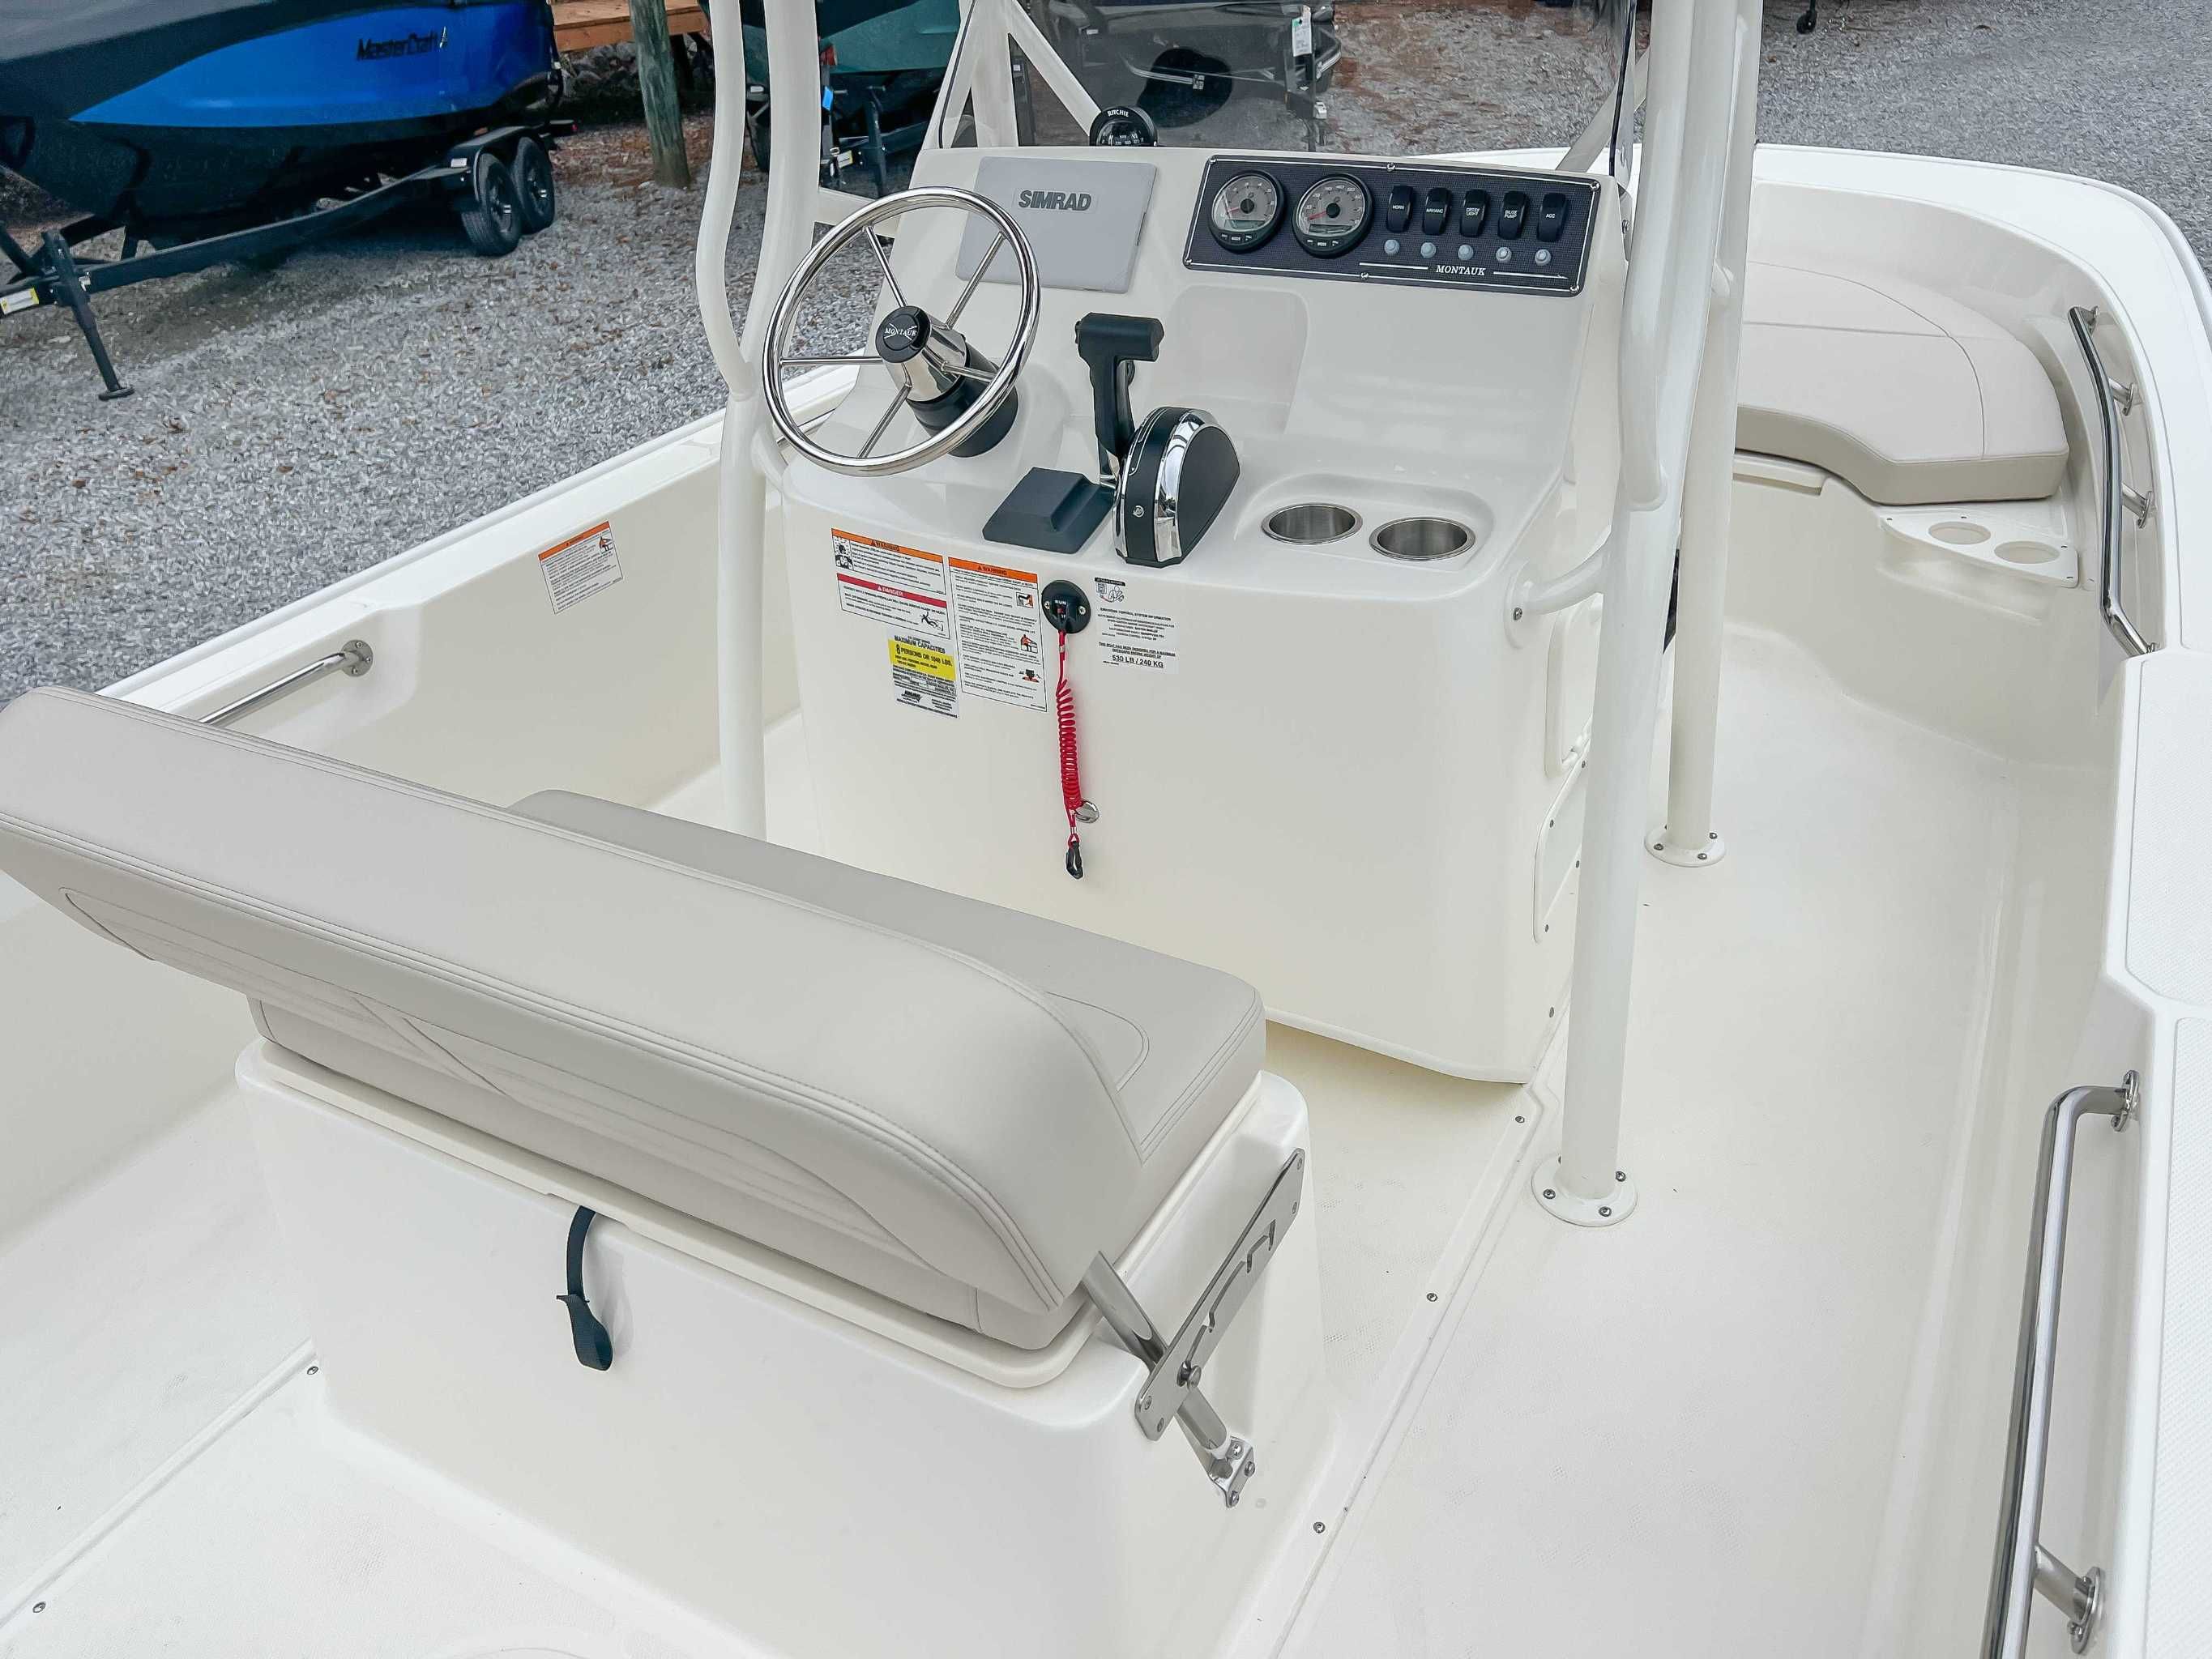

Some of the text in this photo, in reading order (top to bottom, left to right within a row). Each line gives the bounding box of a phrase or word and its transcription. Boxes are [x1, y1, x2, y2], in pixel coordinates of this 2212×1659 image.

[357, 32, 438, 61] MasterCraft
[1107, 109, 1129, 117] RITCHIE
[1018, 190, 1092, 211] SIMRAD
[1436, 264, 1487, 276] MONTAUK
[983, 566, 1008, 576] WARNING
[882, 586, 903, 597] DANGER
[895, 635, 917, 646] MAXIMUM
[918, 641, 946, 654] CAPACITIES
[901, 647, 923, 659] PERSONS
[923, 653, 930, 661] OR
[1139, 659, 1152, 667] 240
[1153, 661, 1164, 669] KG
